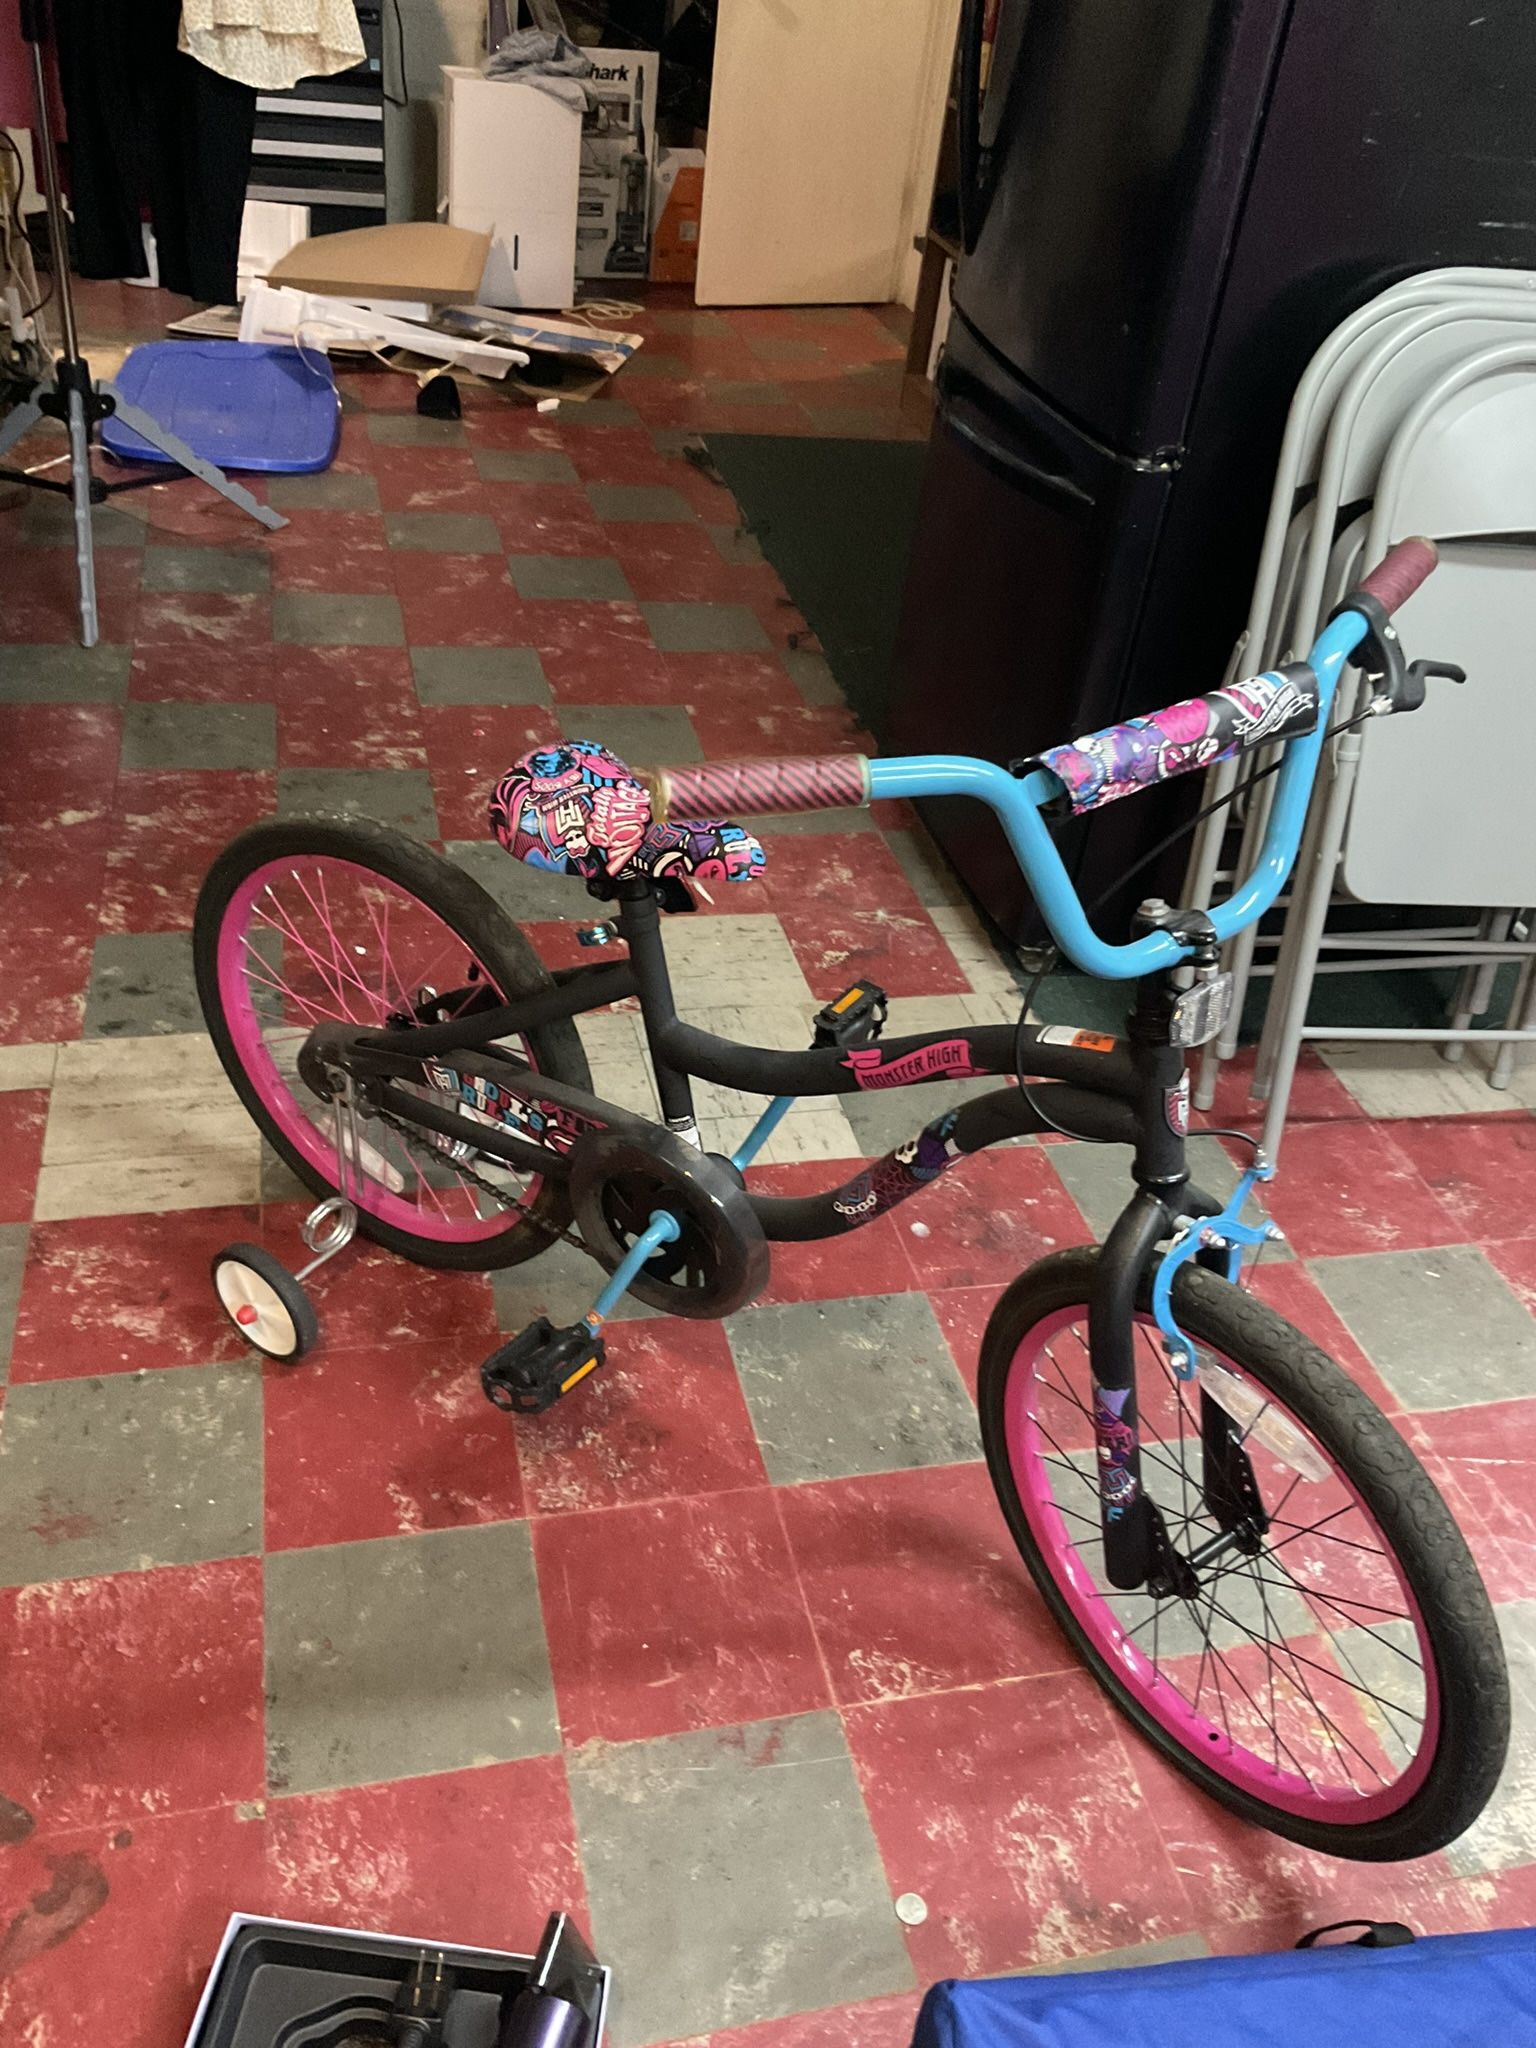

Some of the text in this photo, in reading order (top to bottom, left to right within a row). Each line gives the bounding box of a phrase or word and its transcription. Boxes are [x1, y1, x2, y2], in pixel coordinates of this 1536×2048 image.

[586, 63, 630, 81] hark
[861, 1044, 962, 1090] MONSTER HIGH
